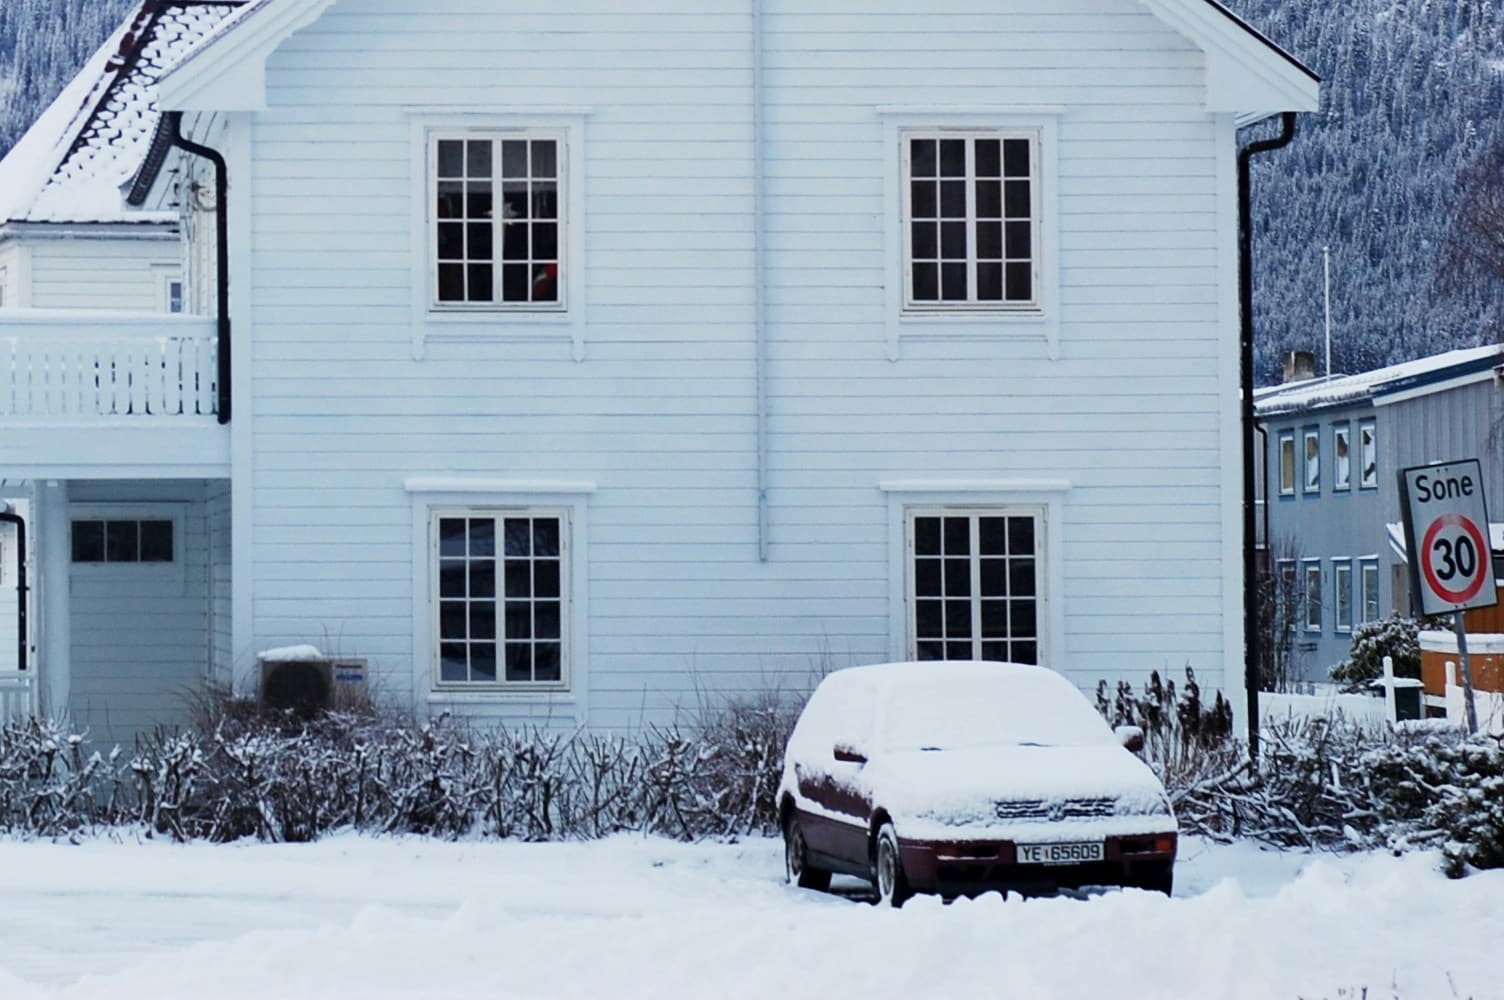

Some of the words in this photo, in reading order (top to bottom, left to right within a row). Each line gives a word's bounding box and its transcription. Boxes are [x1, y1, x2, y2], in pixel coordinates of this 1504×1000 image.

[1415, 475, 1473, 503] Sone
[1433, 535, 1476, 580] 30
[1023, 847, 1041, 861] YE
[1051, 844, 1100, 860] 65609
